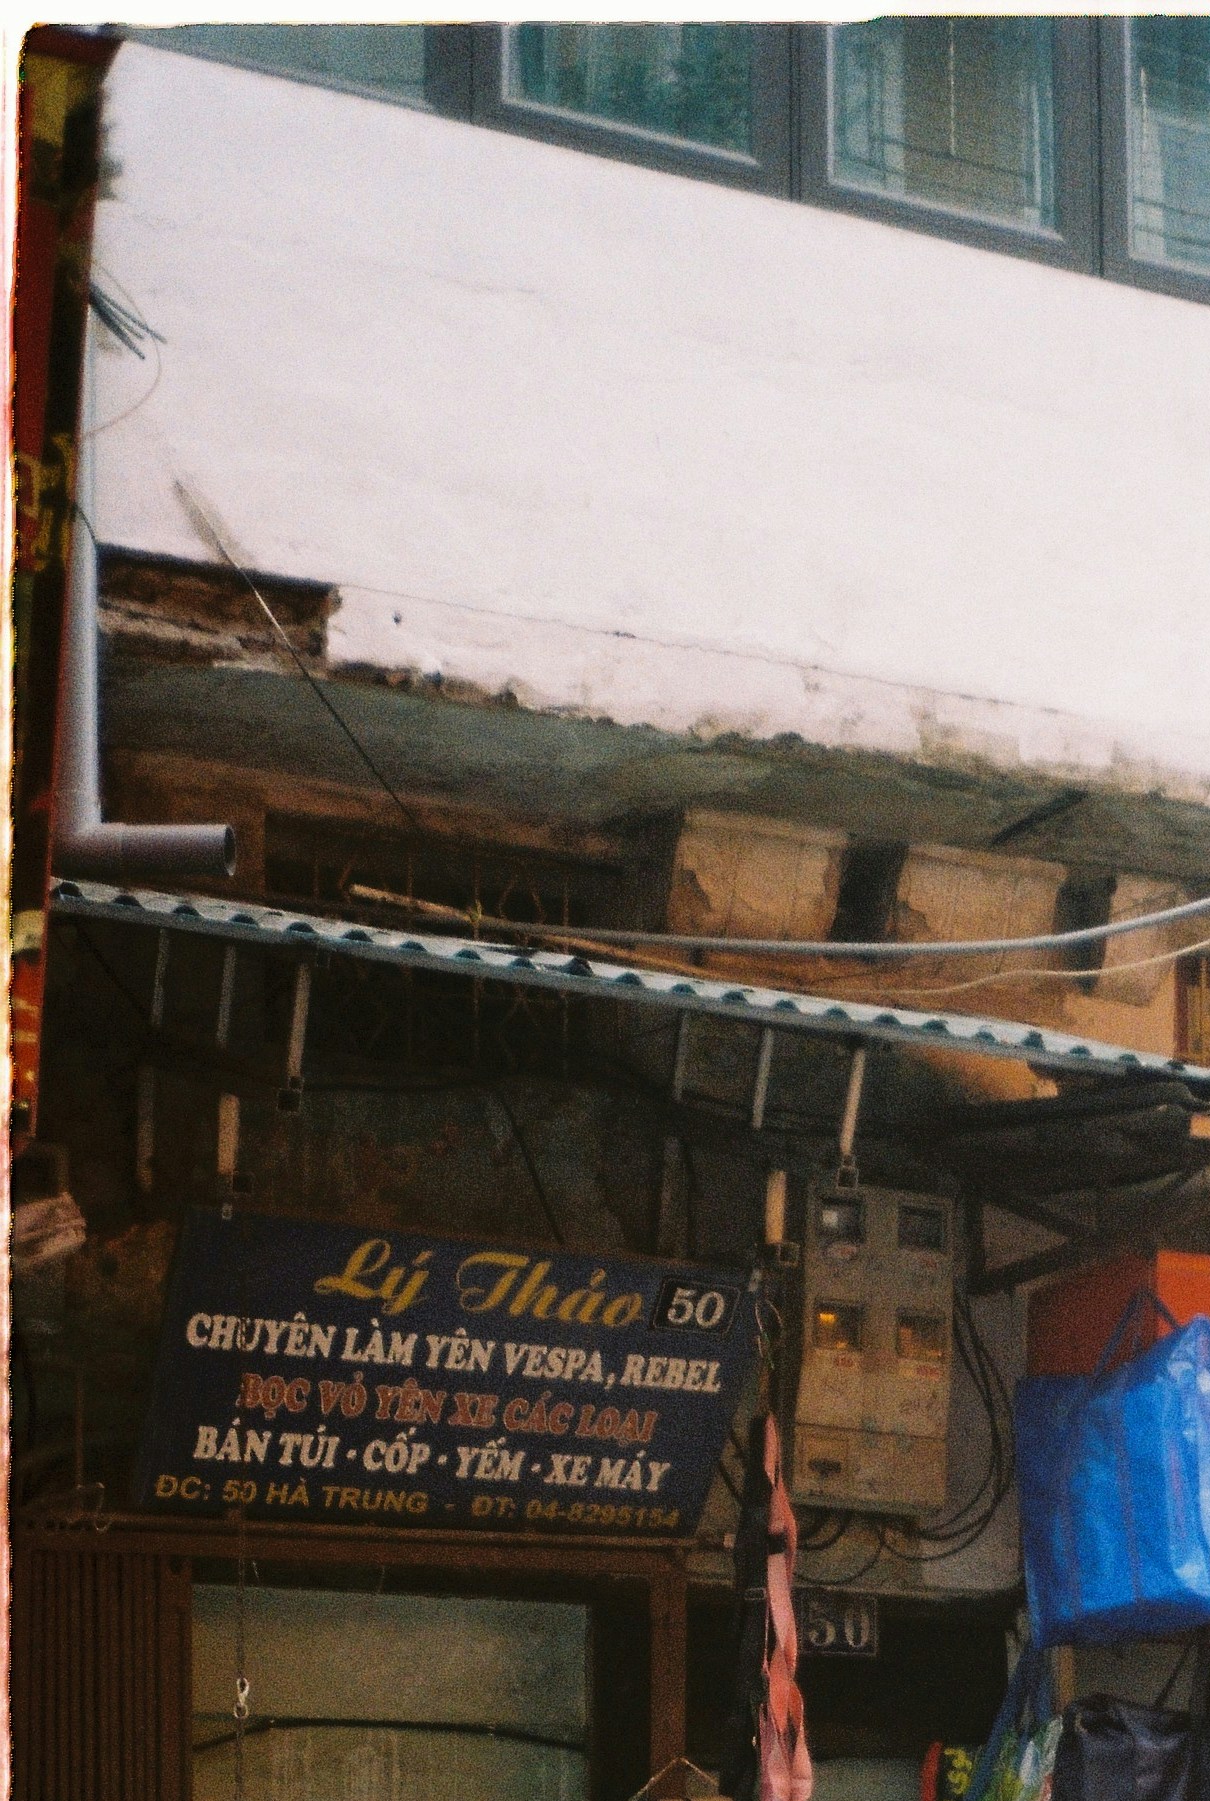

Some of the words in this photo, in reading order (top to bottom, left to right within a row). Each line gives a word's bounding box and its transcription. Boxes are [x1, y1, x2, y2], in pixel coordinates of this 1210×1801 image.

[314, 1238, 435, 1313] Lý
[664, 1288, 725, 1328] 50
[186, 1311, 339, 1360] CHUYÊN
[342, 1318, 416, 1368] LÀM
[425, 1330, 497, 1373] YÊN
[505, 1343, 616, 1388] VESPA,
[621, 1355, 722, 1392] REBEL
[236, 1371, 308, 1420] BỌC
[318, 1371, 369, 1418] VỎ
[375, 1377, 444, 1425] YÊN
[448, 1393, 497, 1427] XE
[504, 1389, 569, 1433] CÁC
[580, 1406, 660, 1446] LOẠI
[277, 1424, 340, 1469] TÚI
[363, 1427, 429, 1474] CỐP
[455, 1437, 526, 1481] YẾM
[543, 1453, 592, 1487] XE
[594, 1450, 671, 1492] MÁY
[154, 1474, 212, 1500] ĐC:
[265, 1478, 310, 1508] HÀ
[322, 1485, 429, 1513] TRUNG
[808, 1603, 870, 1648] 50
